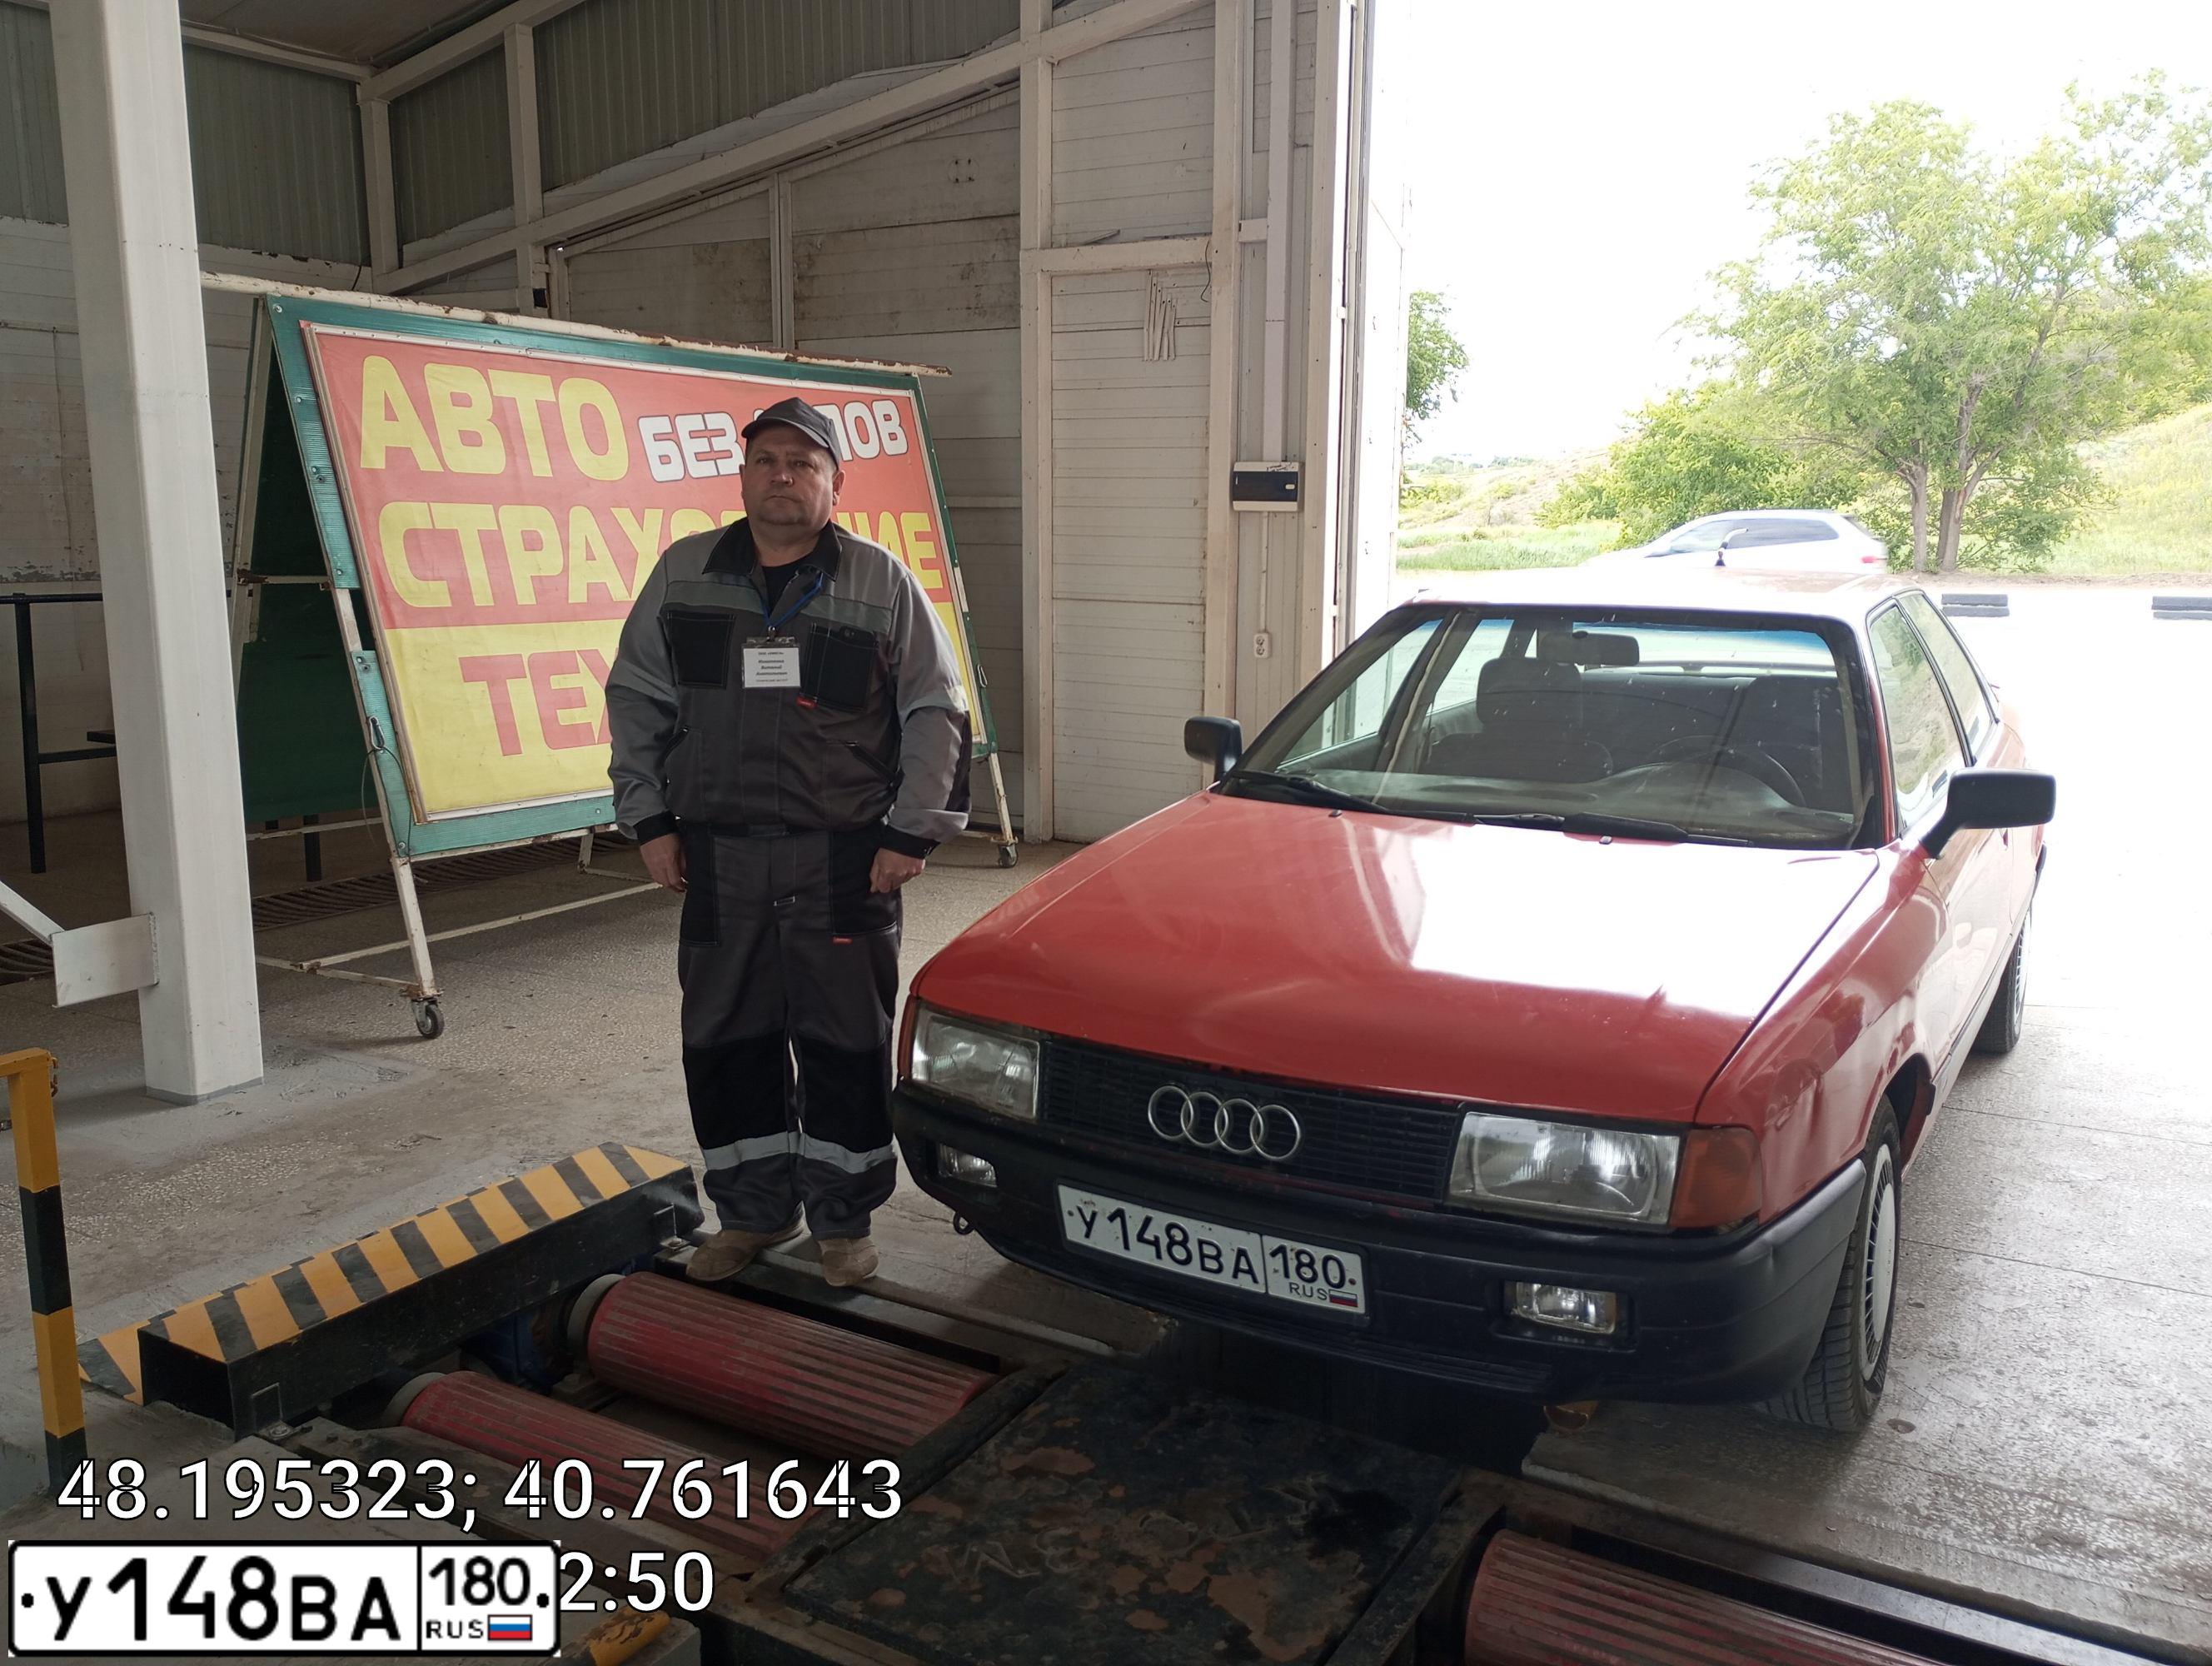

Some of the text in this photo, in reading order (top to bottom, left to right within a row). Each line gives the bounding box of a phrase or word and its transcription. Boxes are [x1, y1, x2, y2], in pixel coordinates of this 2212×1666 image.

[361, 355, 629, 481] АВТО
[638, 412, 745, 482] БЕЗ
[1077, 1205, 1346, 1289] У148ВА 180
[1288, 1282, 1328, 1300] RUS
